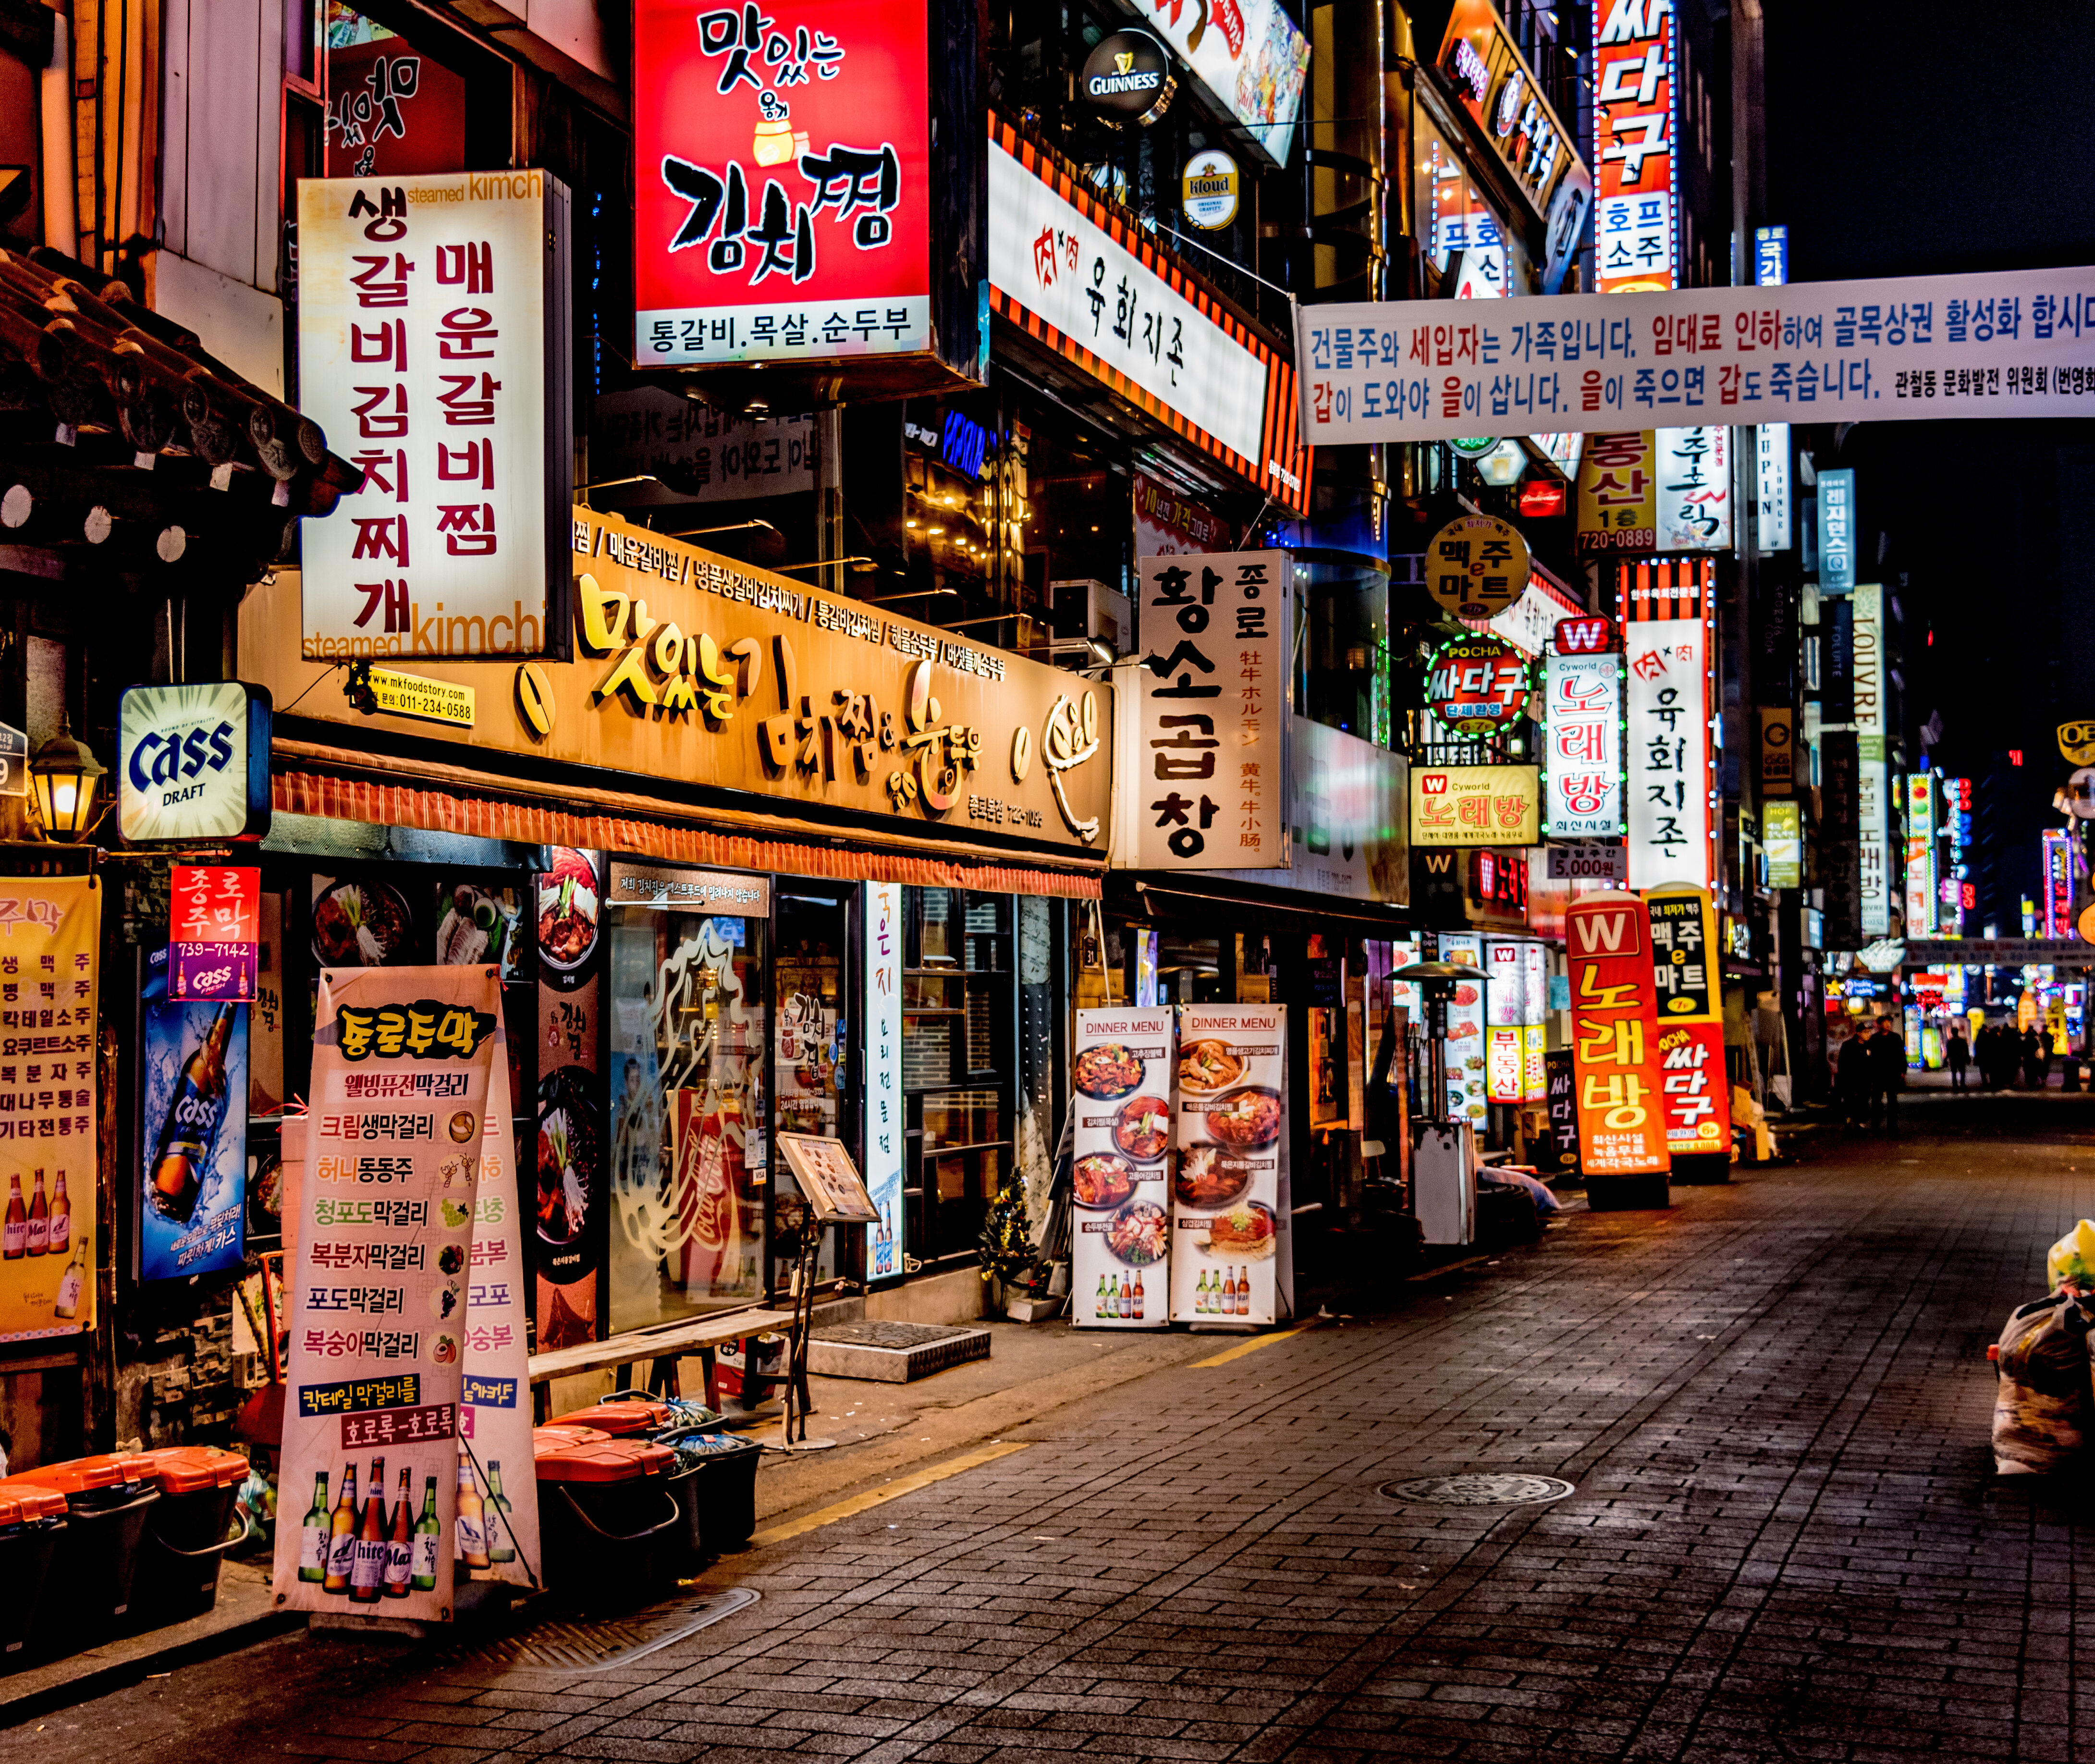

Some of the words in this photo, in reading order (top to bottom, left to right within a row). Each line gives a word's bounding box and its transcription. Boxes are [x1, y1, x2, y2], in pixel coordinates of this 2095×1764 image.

[697, 1, 845, 94] 맛있는
[1089, 72, 1159, 96] GUINNESS
[1598, 0, 1670, 184] 싸다구
[407, 184, 464, 204] steamed
[1189, 176, 1229, 194] Kloud
[1606, 199, 1664, 234] 호프
[1606, 235, 1664, 270] 소주
[1311, 328, 1399, 369] 건물주와
[1409, 323, 1501, 367] 세입자는
[1652, 314, 1722, 355] 임대료
[1735, 309, 1823, 352] 인하하여
[1833, 301, 1933, 348] 골목상권
[1945, 294, 2021, 343] 활성화
[435, 241, 502, 556] 매운갈비찜
[1312, 381, 1351, 424] 갑이
[1361, 377, 1430, 421] 도와야
[1441, 375, 1481, 419] 을이
[1489, 371, 1569, 416] 삽니다.
[1580, 369, 1623, 412] 을이
[1633, 363, 1705, 409] 죽으면
[1718, 363, 1762, 405] 갑도
[1768, 357, 1880, 403] 죽습니다.
[1895, 370, 1936, 398] 관철동
[1943, 367, 2000, 397] 문화발전
[2006, 366, 2048, 395] 위원회
[348, 186, 415, 634] 생갈비김치찌개
[1761, 424, 1771, 514] LUPIN
[1580, 528, 1654, 549] 720-0889
[607, 531, 680, 581] 매운갈비찜
[1439, 540, 1513, 569] 맥주
[1469, 562, 1485, 576] e
[1235, 564, 1269, 639] 종로
[1439, 575, 1511, 602] 마트
[302, 630, 403, 659] steamed
[576, 573, 735, 721] 맛있는
[1562, 622, 1602, 650] W
[1448, 646, 1502, 658] POCHA
[1559, 662, 1597, 672] Cyworld
[369, 674, 465, 701] ww.mkfoodstory.com
[1427, 662, 1525, 705] 싸다구
[1146, 565, 1224, 859] 황소곱창
[129, 720, 234, 794] Cass
[1553, 674, 1615, 816] 노래방
[1425, 778, 1445, 793] W
[1644, 687, 1688, 858] 육회지존
[162, 782, 207, 807] DRAFT
[1452, 783, 1490, 792] Cyworld
[1419, 795, 1530, 829] 노래방
[1556, 820, 1611, 831] 최신시설
[1425, 854, 1451, 873] W
[178, 869, 245, 903] 종로
[620, 876, 636, 891] 저희
[709, 885, 735, 901] 밀려나지
[735, 889, 761, 904] 않습니다
[181, 899, 250, 940] 주막
[1663, 903, 1685, 916] 최저가
[1574, 913, 1626, 954] W
[1650, 920, 1703, 952] 맥주
[178, 942, 249, 958] 739-7142
[1496, 949, 1514, 961] W
[1671, 949, 1687, 965] e
[201, 982, 226, 994] FRESH
[1654, 964, 1707, 995] 마트
[1086, 1022, 1128, 1034] DINNER
[1131, 1020, 1164, 1032] MENU
[1191, 1017, 1237, 1029] DINNER
[1239, 1017, 1276, 1029] MENU
[2, 1034, 91, 1056] 요쿠르트소주
[1577, 964, 1651, 1130] 노래방
[1493, 1031, 1519, 1099] 부동산
[344, 1073, 469, 1098] 웰빙퓨전막걸리
[879, 1017, 891, 1154] 요리전문점
[1663, 1043, 1715, 1126] 싸다구
[0, 1089, 91, 1112] 대나무통술
[1550, 1074, 1577, 1149] 싸다구
[0, 1115, 90, 1139] 기타전통주
[320, 1113, 434, 1140] 크림생막걸리
[318, 1156, 414, 1183] 허니동동주
[755, 1171, 765, 1179] VISA
[315, 1199, 429, 1226] 청포도막걸리
[215, 1225, 236, 1250] 카스
[310, 1242, 425, 1270] 복분자막걸리
[306, 1287, 403, 1313] 포도막걸리
[303, 1330, 419, 1358] 복숭아막걸리
[303, 1384, 353, 1412] 칵테일
[356, 1376, 417, 1407] 막걸리를
[346, 1406, 453, 1446] 호로록-호로록
[357, 1542, 384, 1559] hite
[385, 1547, 412, 1567] Max
